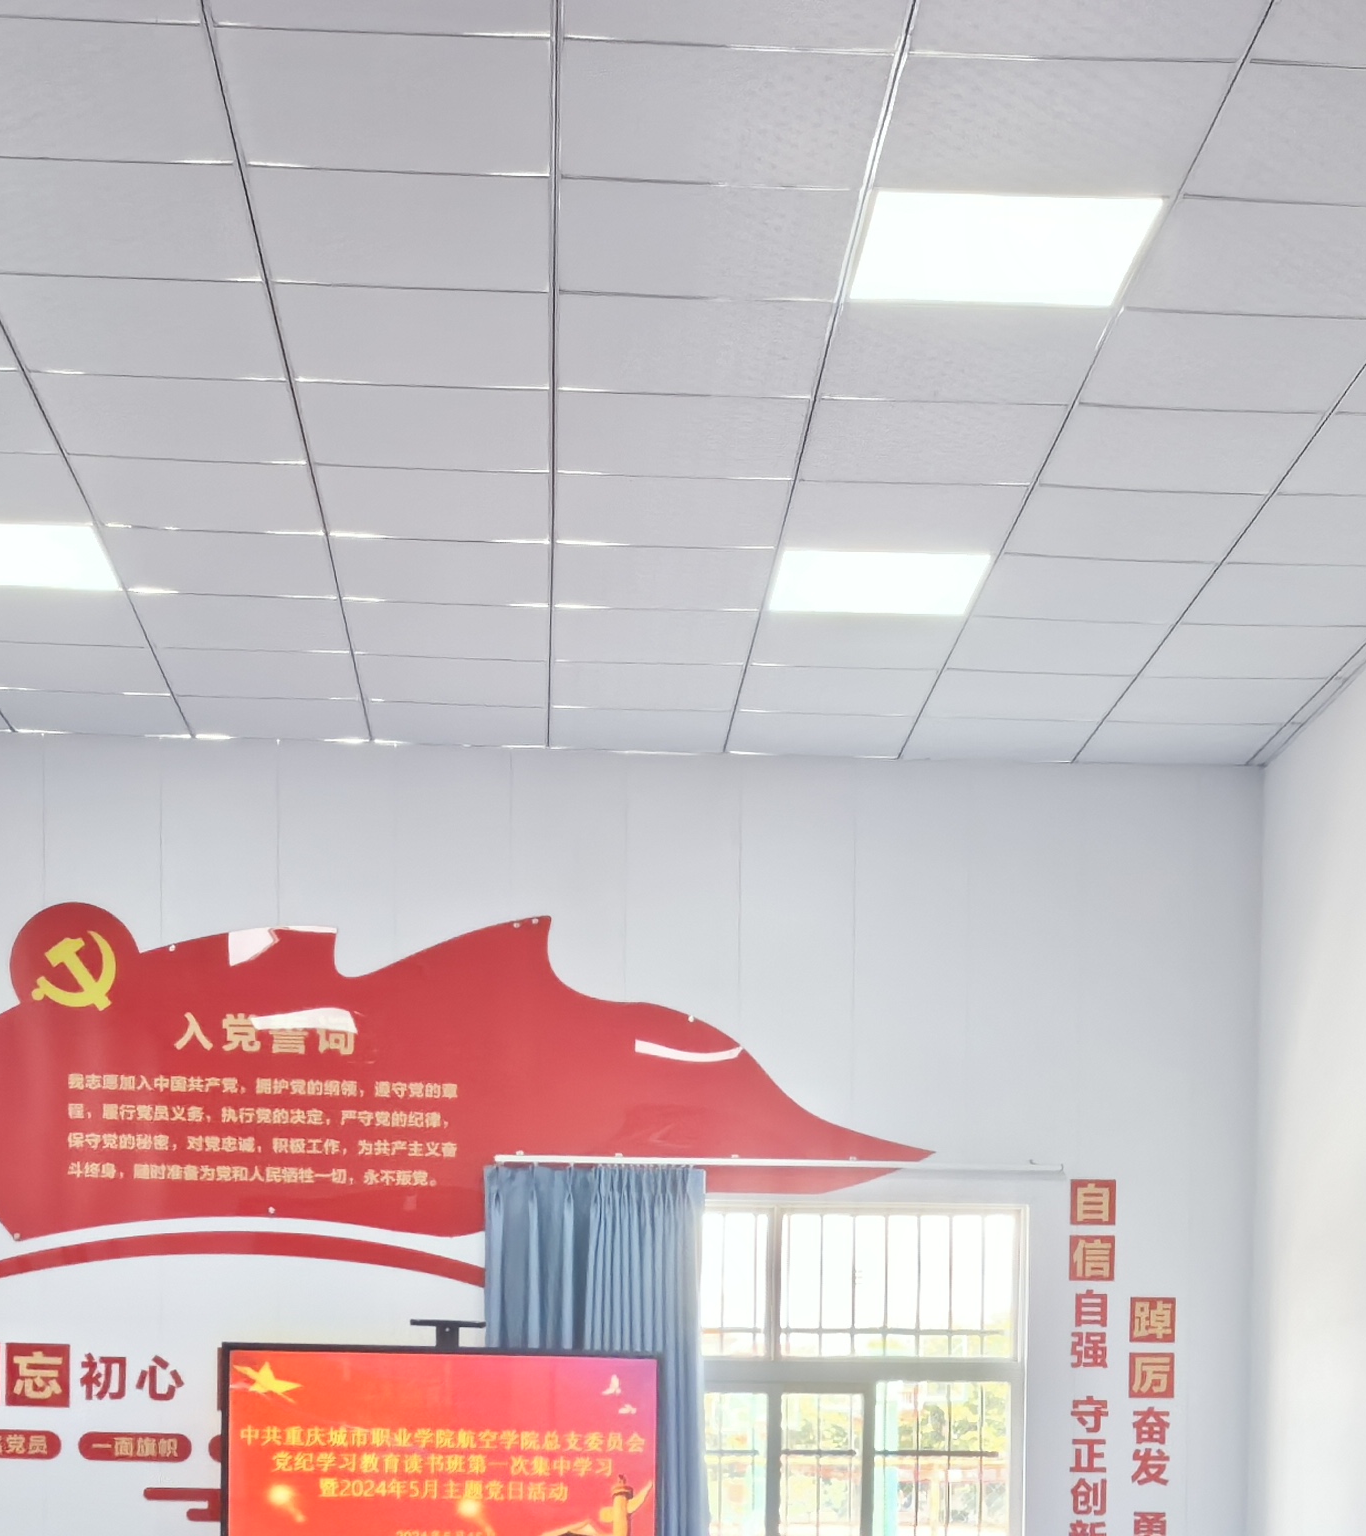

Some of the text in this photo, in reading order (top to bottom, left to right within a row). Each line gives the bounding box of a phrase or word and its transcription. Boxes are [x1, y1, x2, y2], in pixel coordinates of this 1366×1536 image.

[1070, 1183, 1113, 1369] 自信自强
[1130, 1300, 1173, 1486] 踔厉奋发
[92, 1436, 179, 1457] 一面旗帜
[239, 1425, 646, 1454] 中共重庆城市职业学院航空学院总支委员会
[271, 1451, 613, 1477] 党纪学习教育读书班第一次集中学习
[319, 1477, 569, 1503] 暨2024年5月主题党日活动
